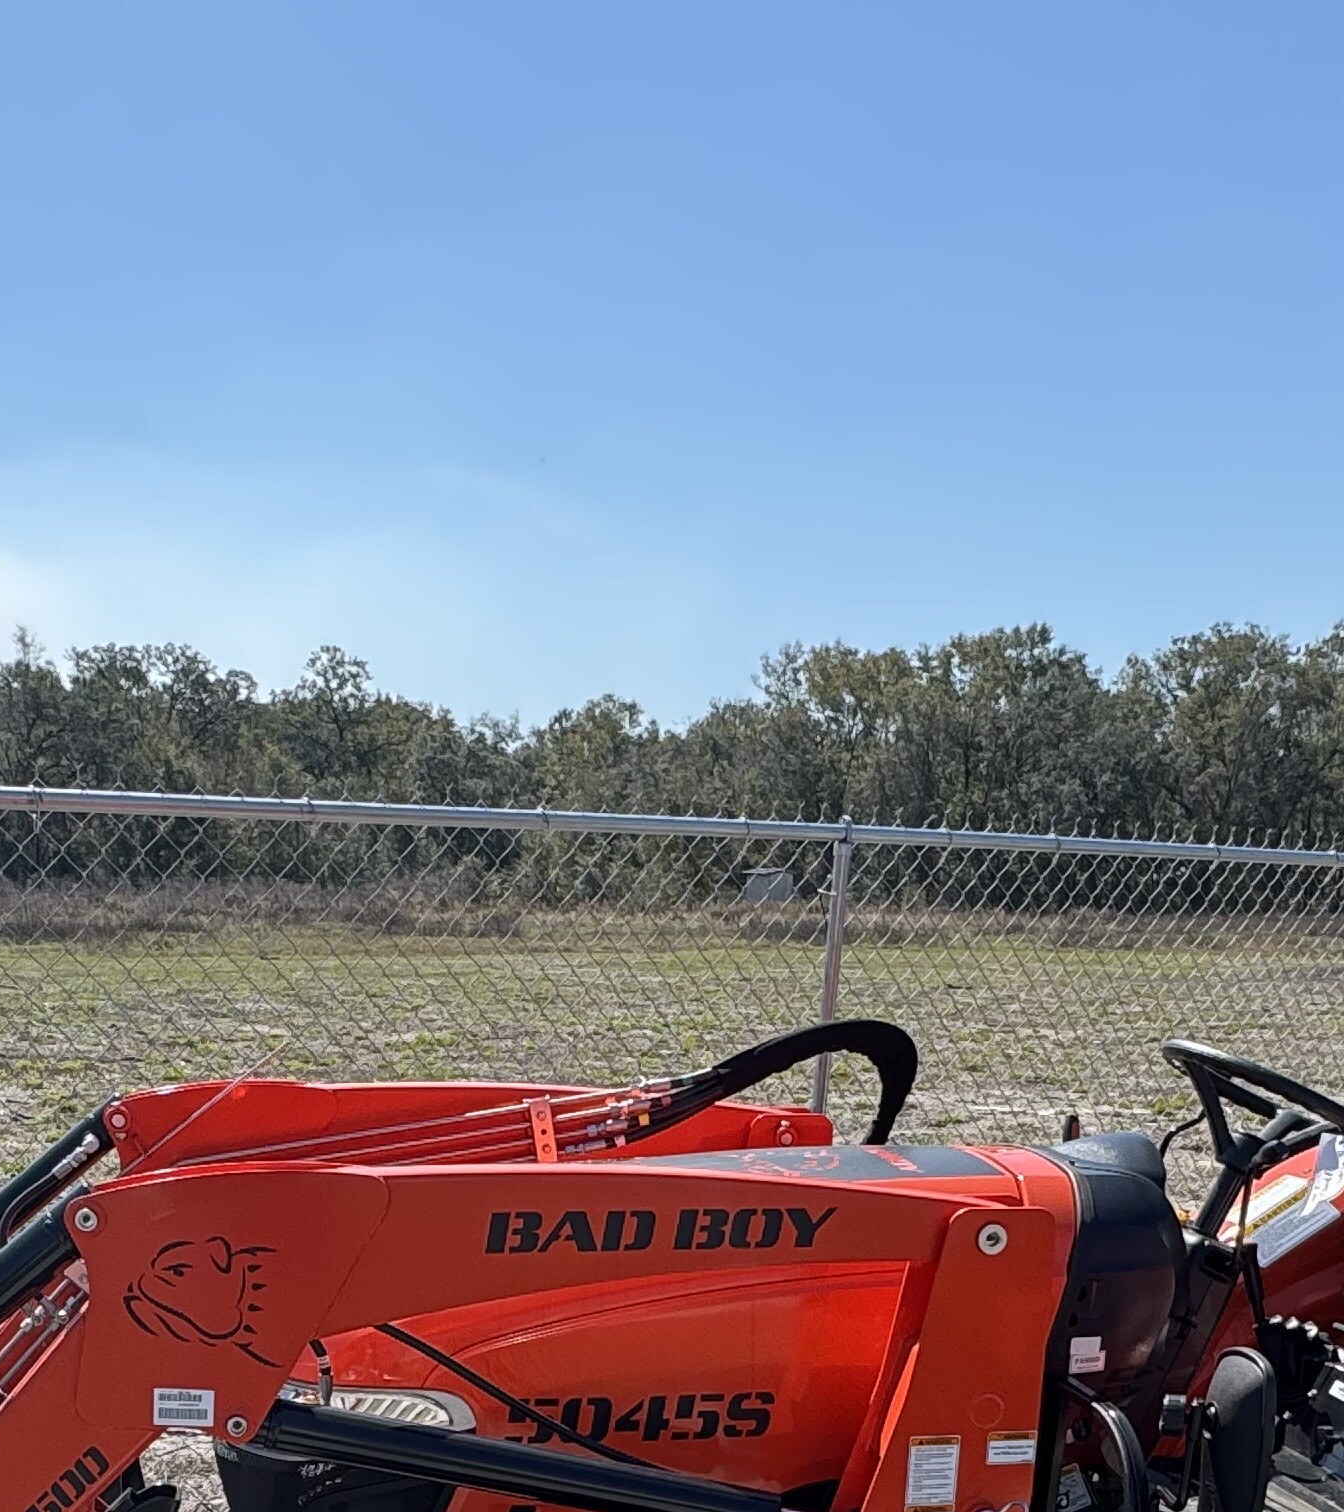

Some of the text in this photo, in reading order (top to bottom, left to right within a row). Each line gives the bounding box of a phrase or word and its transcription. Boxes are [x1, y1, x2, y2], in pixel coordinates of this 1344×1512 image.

[484, 1206, 839, 1255] BAD BOY
[504, 1391, 776, 1444] 5045S
